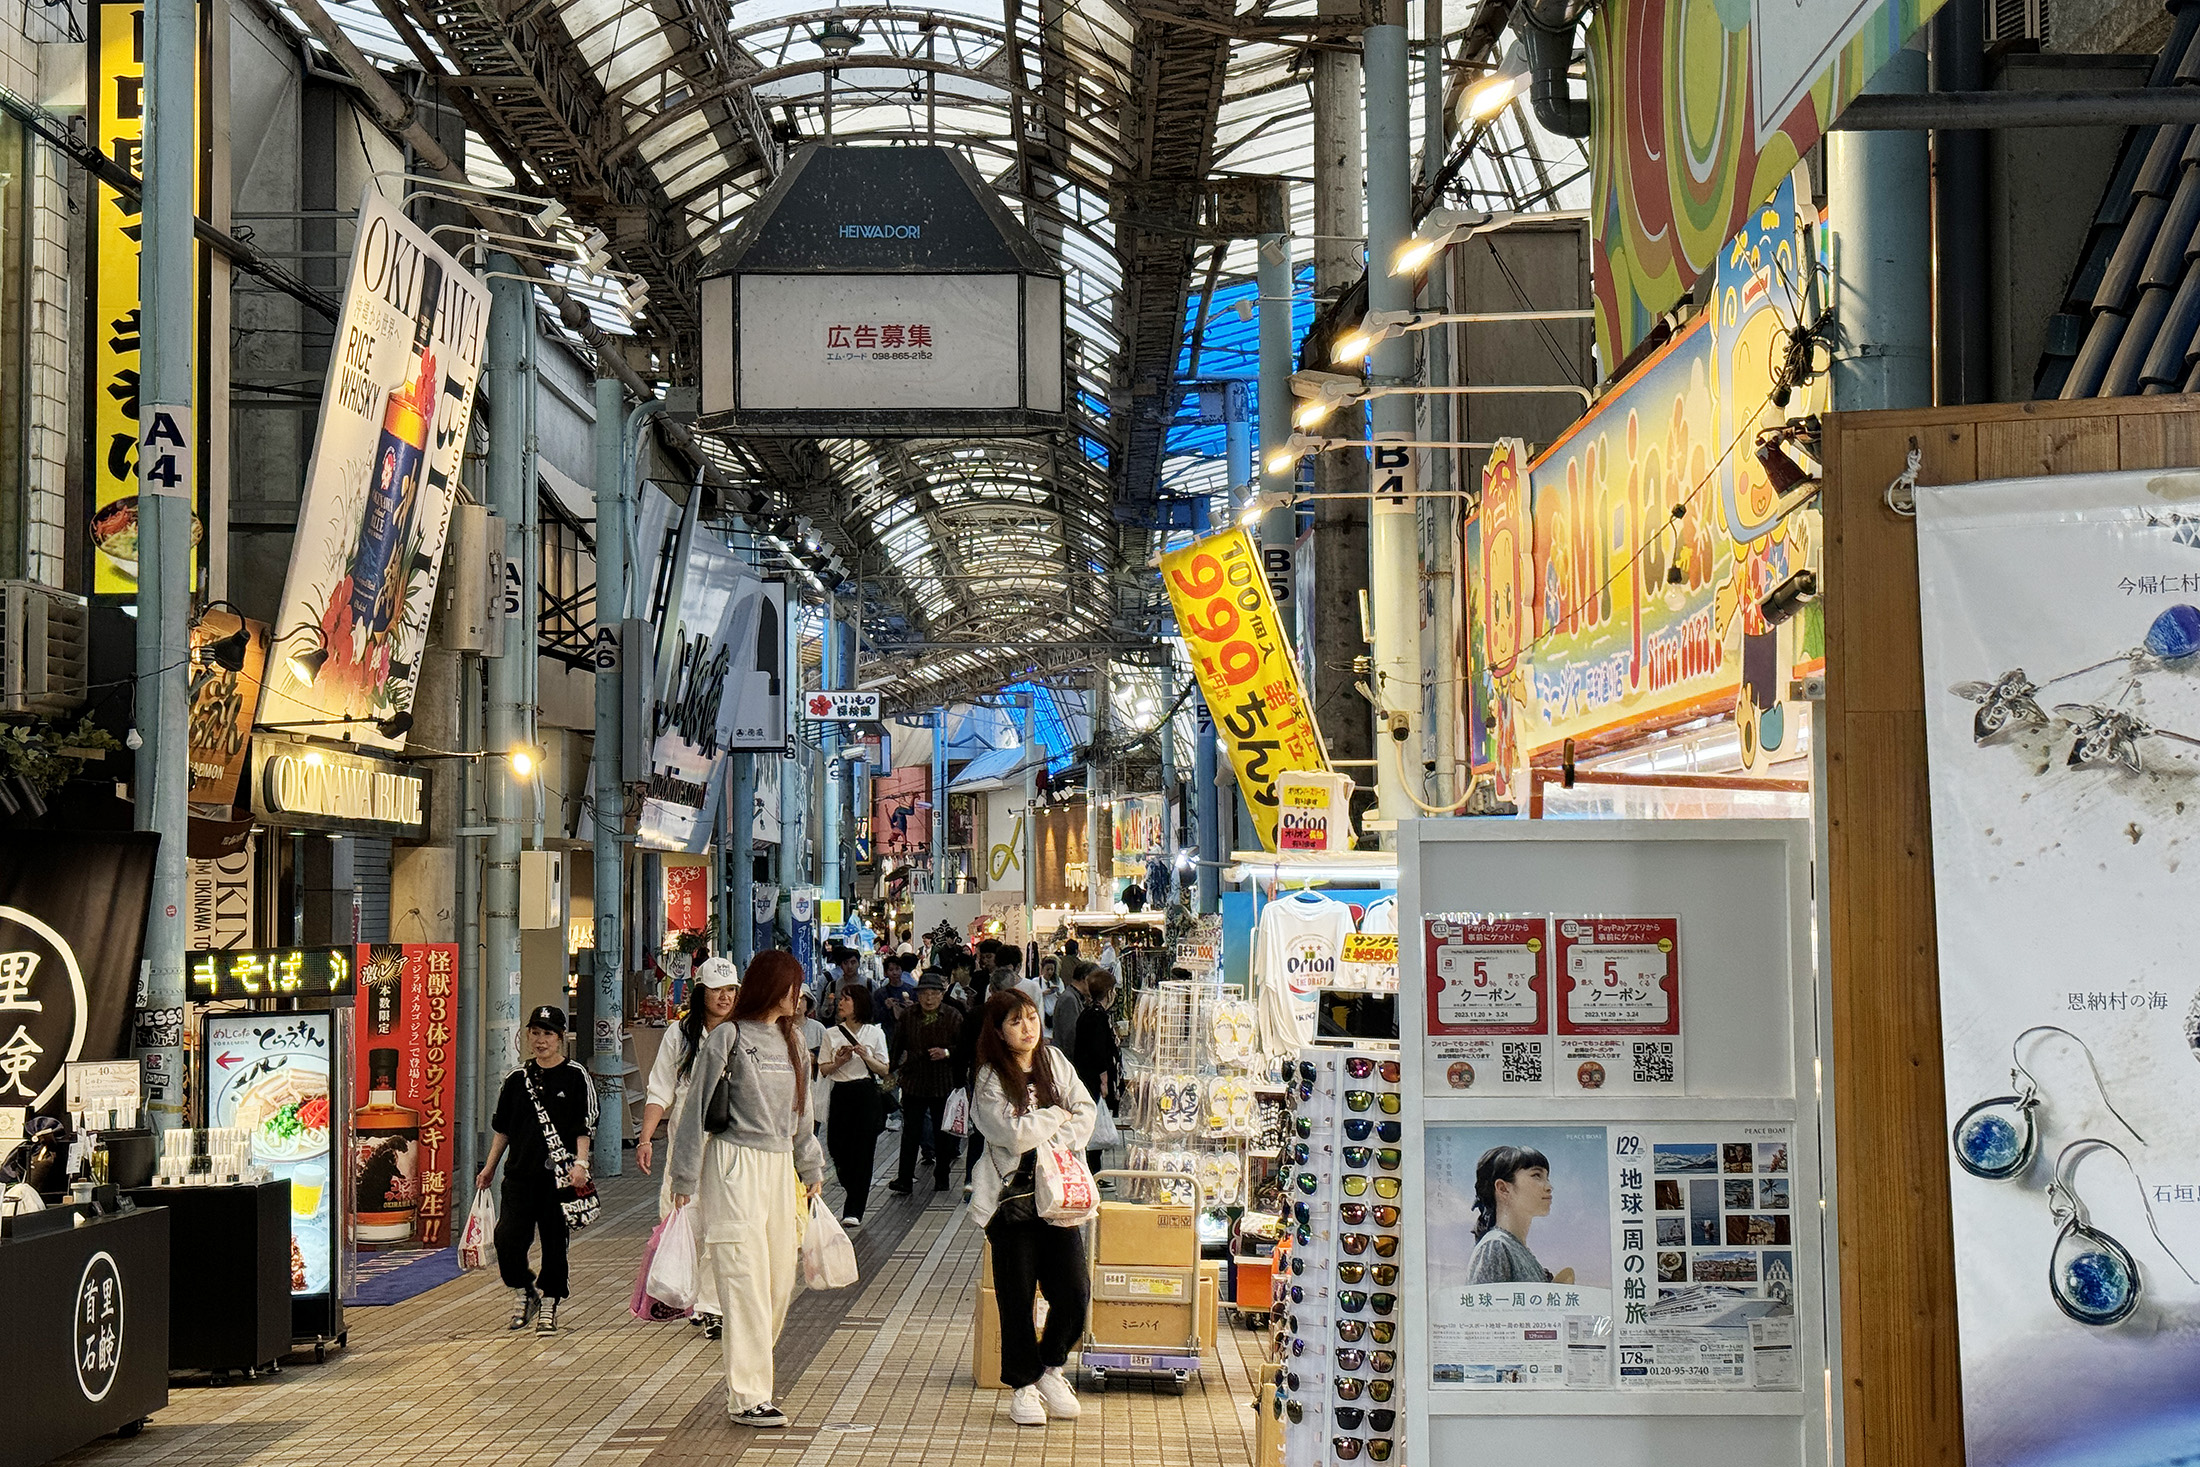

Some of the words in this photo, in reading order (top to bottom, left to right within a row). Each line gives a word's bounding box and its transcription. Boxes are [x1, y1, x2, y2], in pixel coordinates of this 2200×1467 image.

[839, 224, 921, 240] HEIWADORI
[363, 216, 481, 369] OKIAWA
[826, 324, 933, 350] 広告募集
[345, 325, 376, 376] RICE
[871, 352, 933, 361] 098-865-2152
[338, 366, 381, 422] WHISKY
[455, 374, 474, 436] FROM
[434, 448, 460, 552] OKINAWA
[428, 560, 440, 589] TO
[2116, 572, 2200, 596] 今帰仁村
[417, 600, 431, 640] THE
[1648, 633, 1678, 691] Since
[832, 695, 876, 706] いいもの
[278, 754, 375, 820] OKINAWA
[374, 771, 423, 825] BLUE
[1283, 811, 1328, 830] Orion
[194, 879, 212, 933] OKINAWA
[1467, 923, 1530, 933] PayPayアプリから
[1597, 923, 1661, 932] PayPayアプリから
[360, 955, 410, 986] 激レア
[1287, 956, 1335, 973] Orion
[1460, 988, 1517, 1002] クーポン
[1591, 988, 1647, 1002] クーポン
[2066, 990, 2169, 1012] 恩納村の海
[377, 984, 392, 1035] 本数限定
[1616, 1136, 1639, 1156] 129
[1620, 1168, 1648, 1325] 地球一周の船旅
[83, 1277, 115, 1325] 首里
[1460, 1291, 1581, 1308] 地球一周の船旅
[1650, 1367, 1710, 1376] 0120-95-3740
